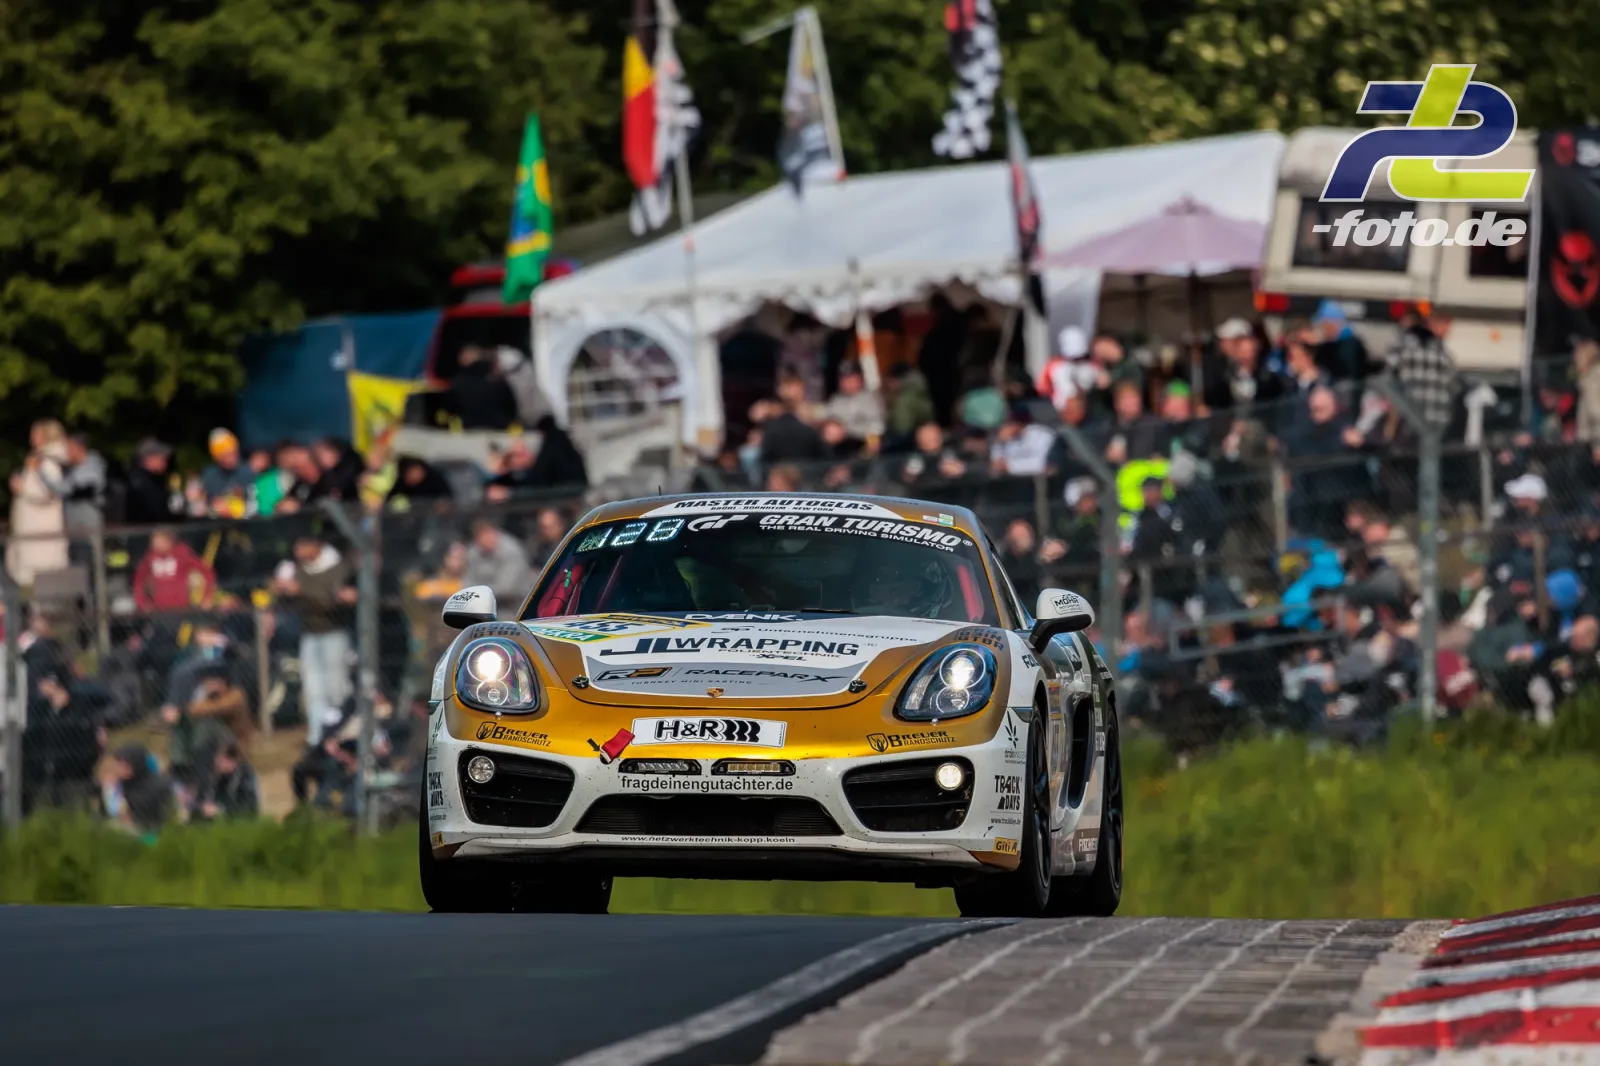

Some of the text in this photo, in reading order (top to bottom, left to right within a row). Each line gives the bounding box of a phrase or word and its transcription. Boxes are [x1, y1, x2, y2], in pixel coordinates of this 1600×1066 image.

[674, 499, 761, 509] MASTER
[763, 498, 874, 511] AUTOGLAS
[760, 514, 837, 527] GRAN
[843, 517, 962, 547] TURISMO
[824, 526, 877, 537] DRIVING
[880, 533, 954, 553] SIMULATOR
[675, 636, 860, 656] WRAPPING
[718, 648, 841, 658] FOLIENTECHNIK
[684, 668, 851, 683] RACEPARX
[656, 720, 721, 739] H&R
[621, 776, 793, 792] fragdeinengutachter.de
[994, 775, 1020, 794] TRACK
[1004, 795, 1020, 810] DAYS
[621, 836, 796, 844] www.netzwerktechnik-kopp.koeln
[995, 840, 1010, 852] Giti
